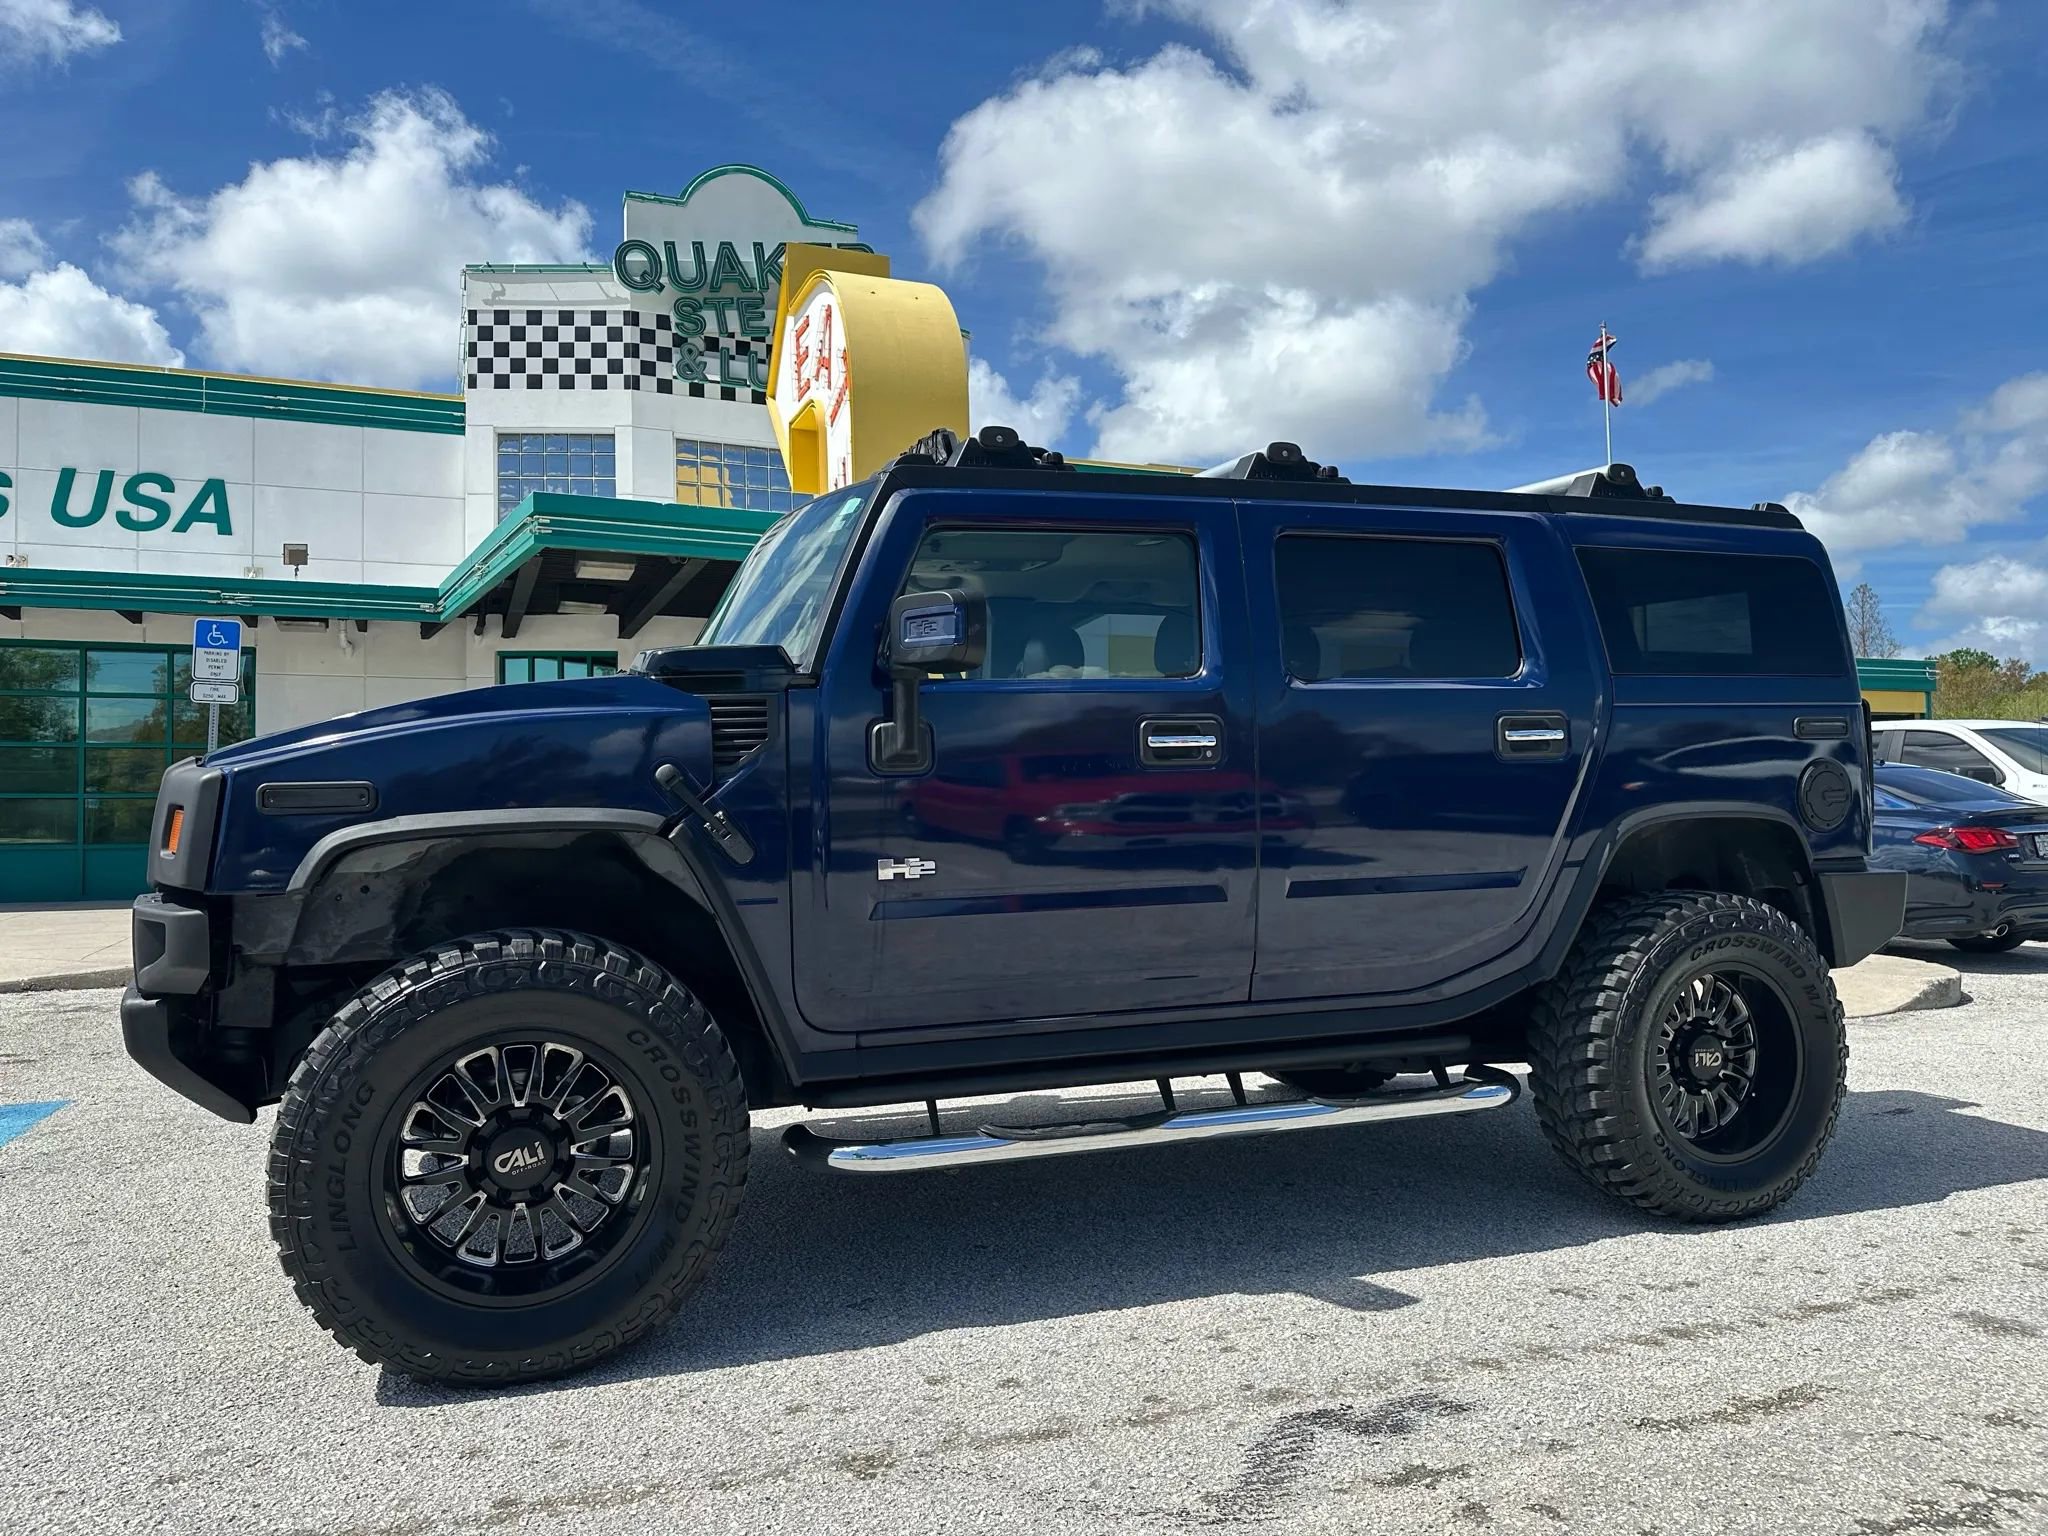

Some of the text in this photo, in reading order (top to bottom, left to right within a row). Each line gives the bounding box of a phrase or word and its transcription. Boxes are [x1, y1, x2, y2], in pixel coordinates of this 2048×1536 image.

[615, 239, 874, 295] QUAK
[675, 341, 708, 384] &
[50, 467, 233, 536] USA
[878, 857, 936, 880] H2
[1690, 934, 1829, 1024] CROSSWIND M/T
[626, 1030, 700, 1224] CROSSWIND
[327, 1080, 376, 1252] LINGLONG
[511, 1160, 547, 1175] OFF-ROAD
